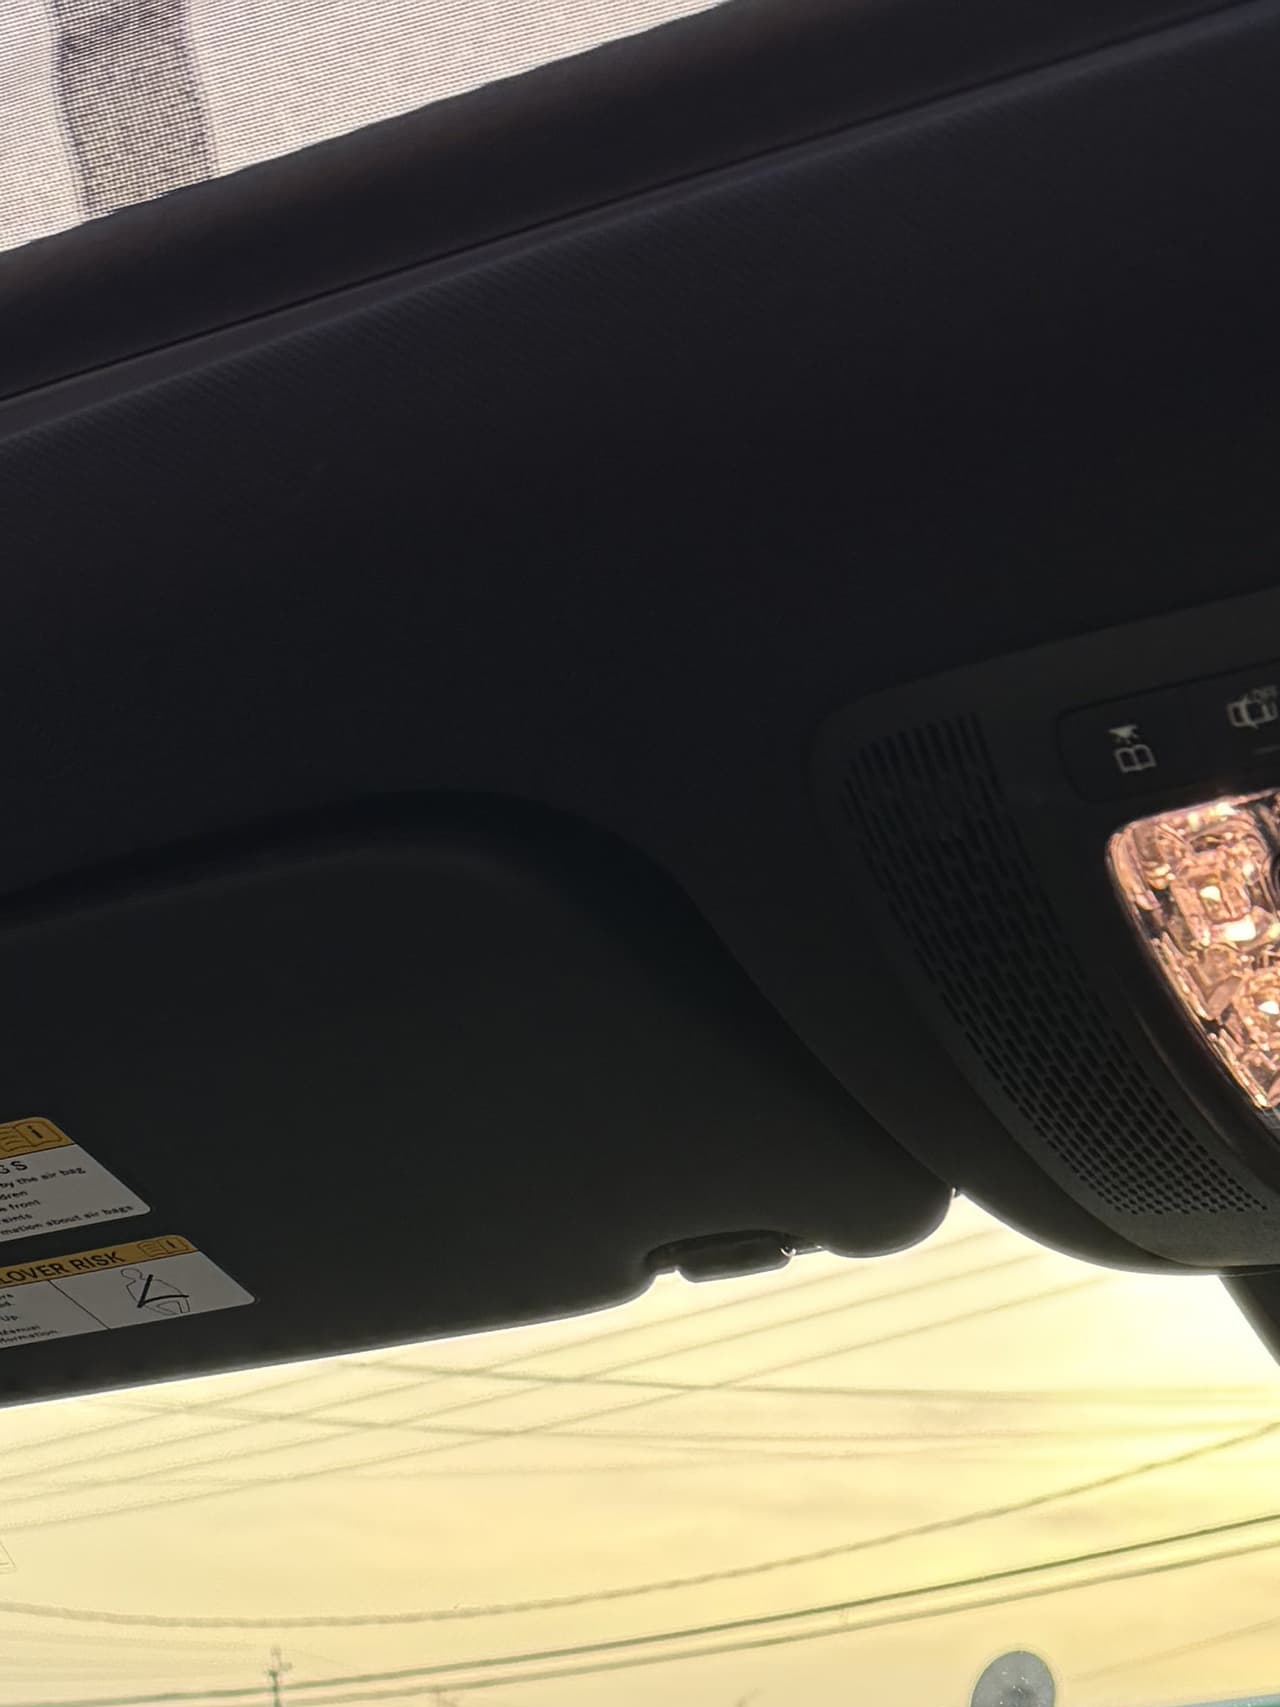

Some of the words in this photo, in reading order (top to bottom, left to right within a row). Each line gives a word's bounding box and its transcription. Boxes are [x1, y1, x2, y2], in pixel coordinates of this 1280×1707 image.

[15, 1176, 39, 1185] the
[39, 1172, 58, 1181] air
[57, 1167, 87, 1177] bag
[69, 1251, 124, 1270] RISK
